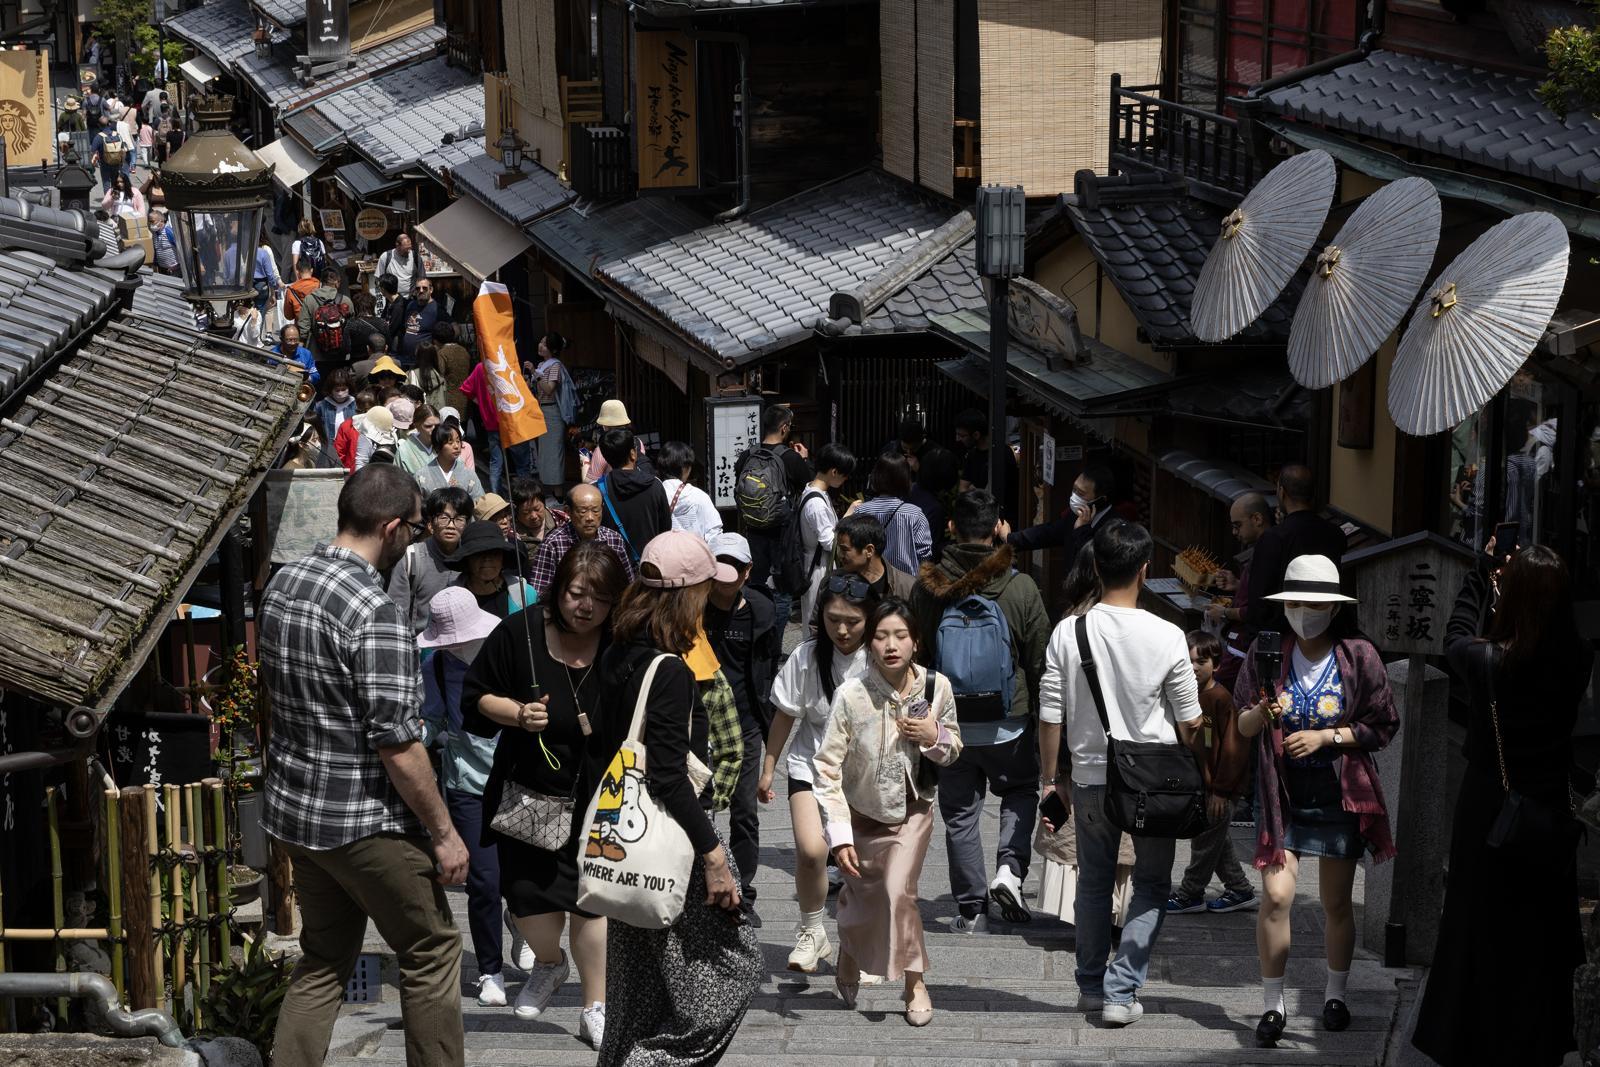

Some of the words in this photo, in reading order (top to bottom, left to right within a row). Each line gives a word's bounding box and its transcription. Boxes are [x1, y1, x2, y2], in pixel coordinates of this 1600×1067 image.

[36, 57, 45, 116] STARBUCKS
[747, 411, 757, 448] そば処
[716, 456, 733, 498] ふたば
[1405, 563, 1437, 642] 二寧坂
[583, 861, 615, 882] WHERE
[616, 871, 640, 887] ARE
